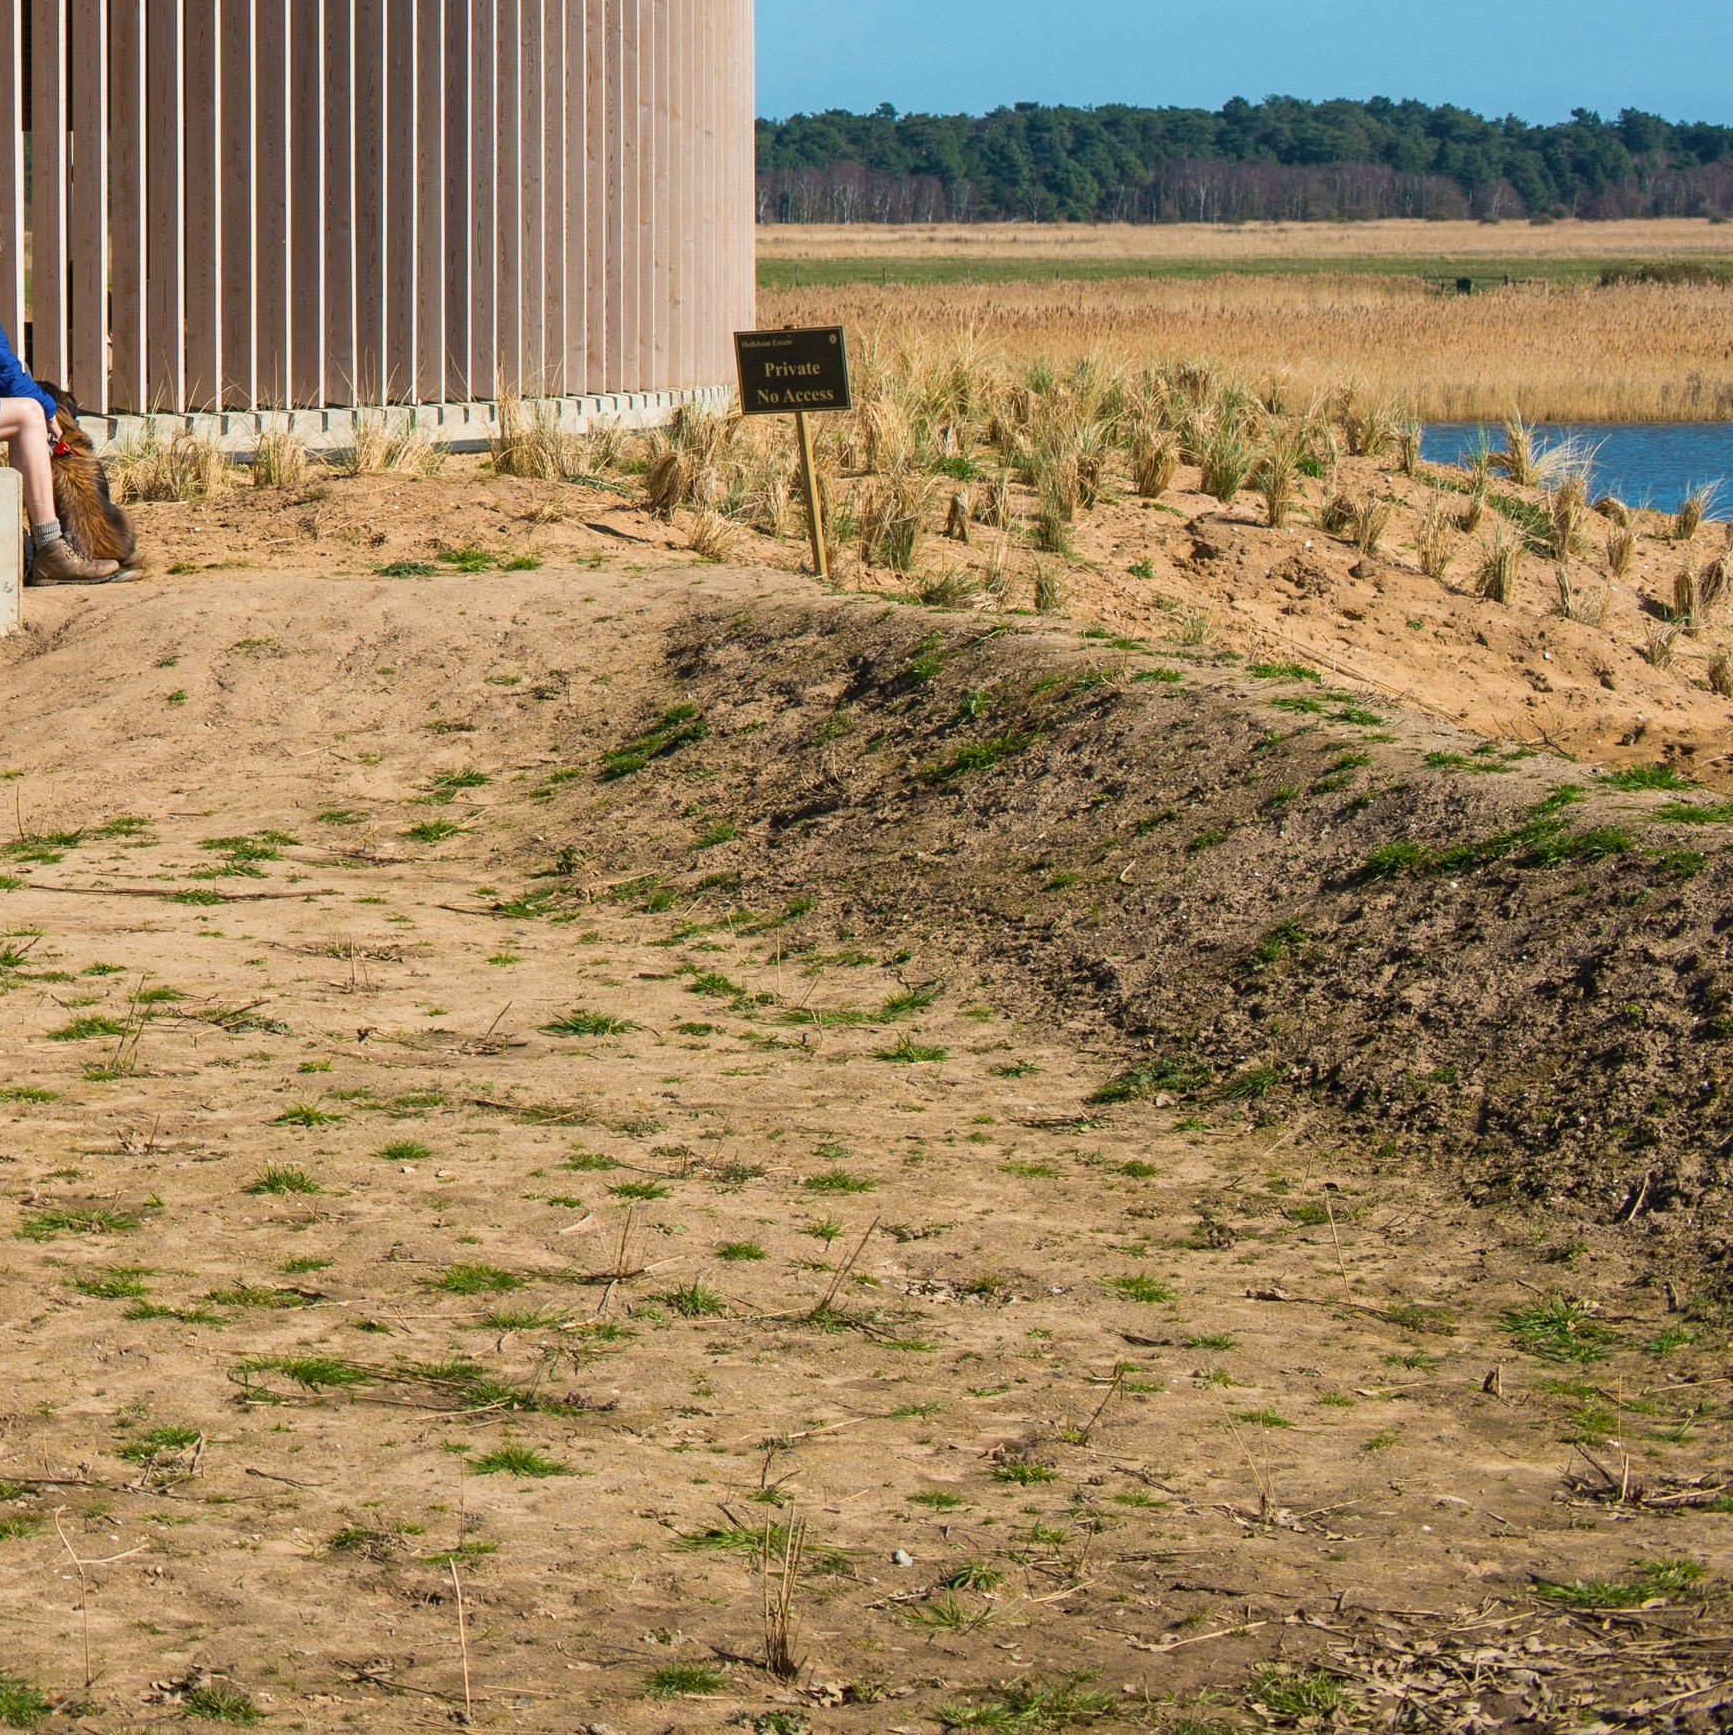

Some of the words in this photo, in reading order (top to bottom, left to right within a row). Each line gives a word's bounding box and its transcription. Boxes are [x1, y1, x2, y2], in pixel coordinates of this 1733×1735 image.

[764, 361, 821, 377] Private
[756, 389, 779, 404] No
[783, 388, 834, 402] Access
